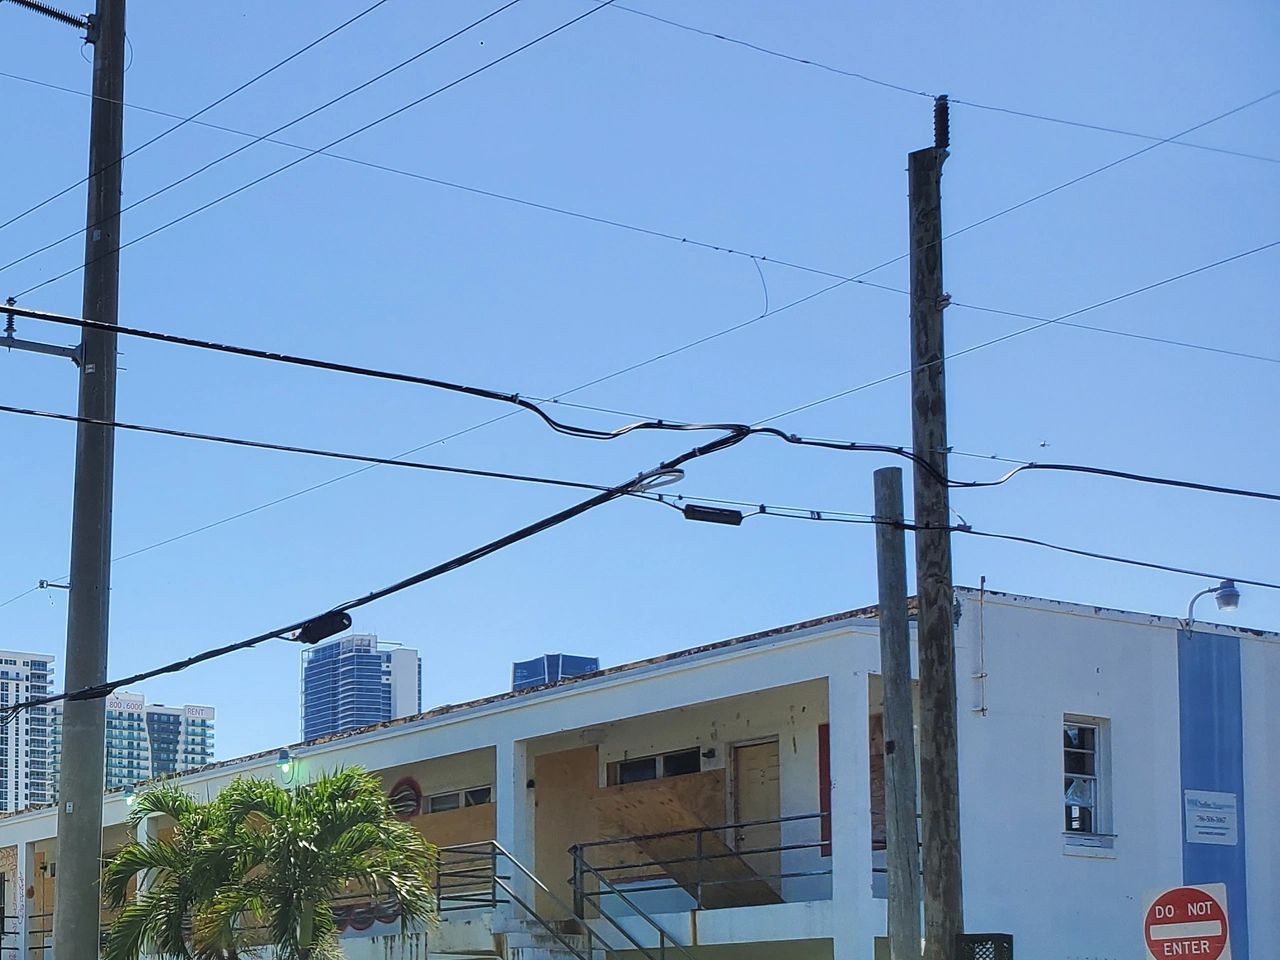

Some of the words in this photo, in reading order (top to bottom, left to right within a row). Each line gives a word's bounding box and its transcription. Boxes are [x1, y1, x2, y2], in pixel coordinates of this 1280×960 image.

[187, 707, 205, 717] RENT
[1155, 905, 1175, 919] DO
[1187, 901, 1213, 916] NOT
[1164, 940, 1210, 956] ENTER
